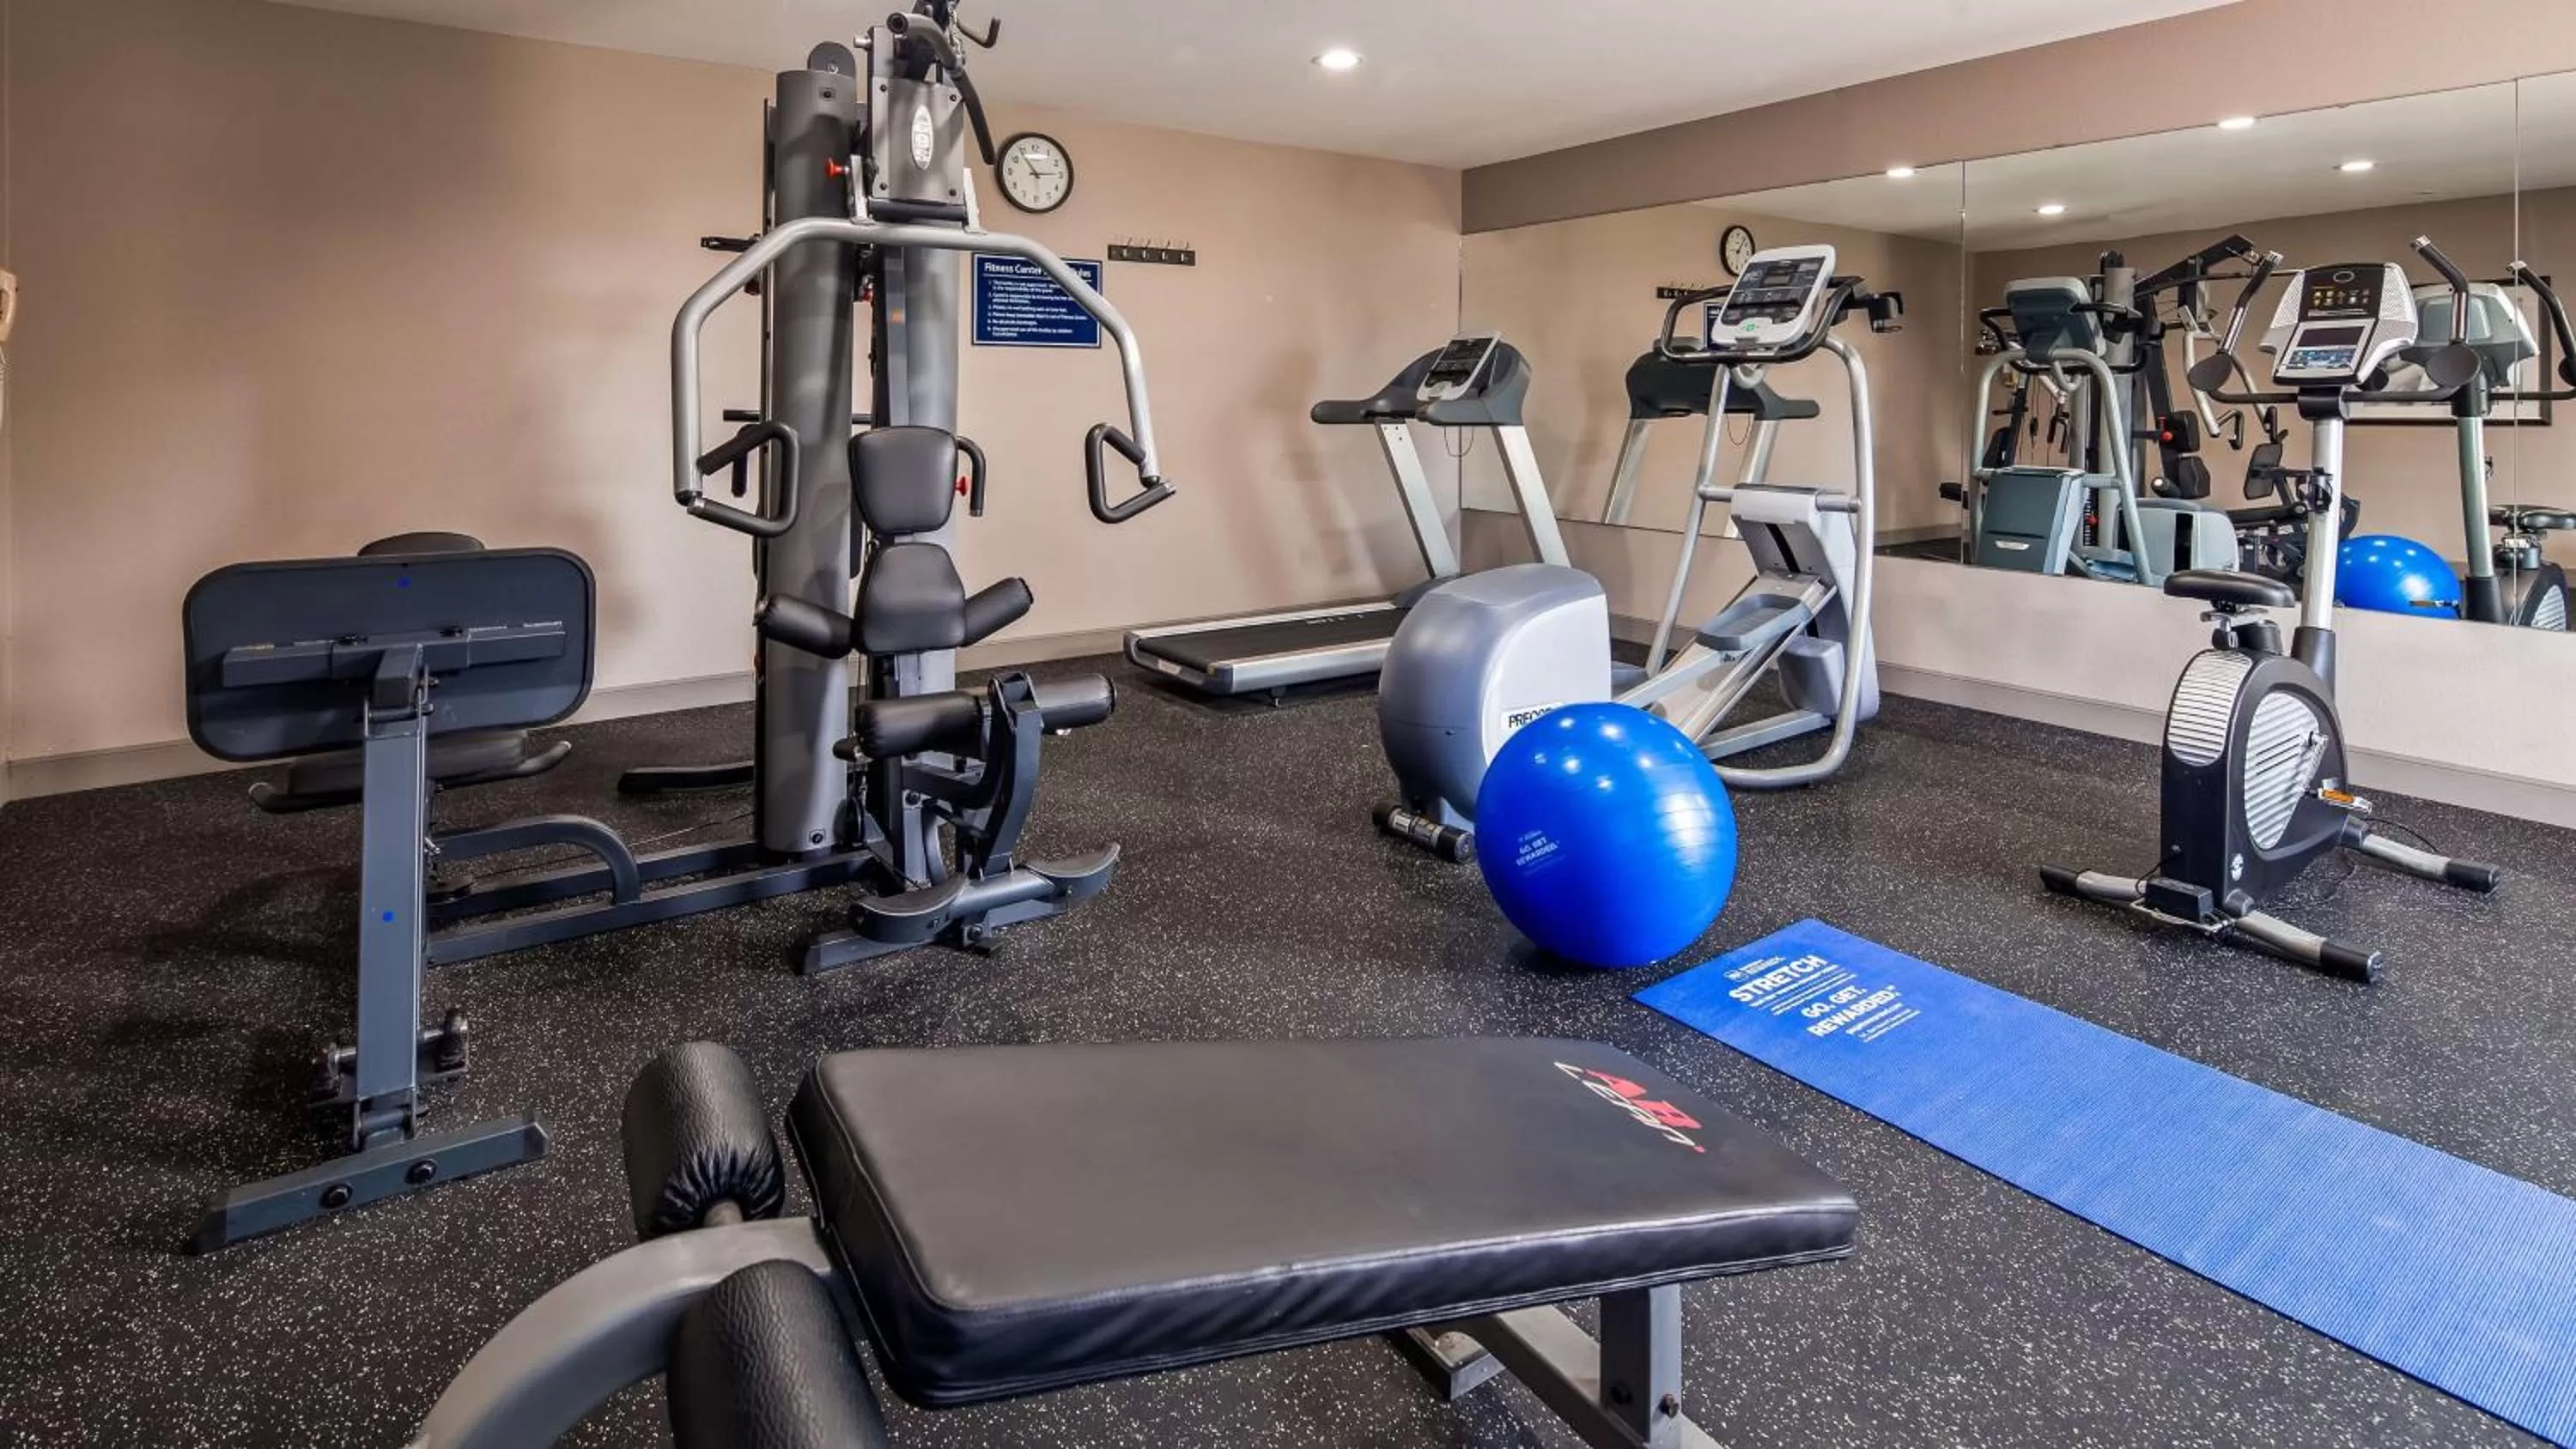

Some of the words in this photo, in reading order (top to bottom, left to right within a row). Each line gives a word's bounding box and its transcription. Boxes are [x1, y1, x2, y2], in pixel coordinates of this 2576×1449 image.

[984, 263, 1014, 274] Fitness
[1728, 955, 1828, 1003] STRETCH
[1801, 1002, 1837, 1018] GO.
[1828, 985, 1868, 1004] GET.
